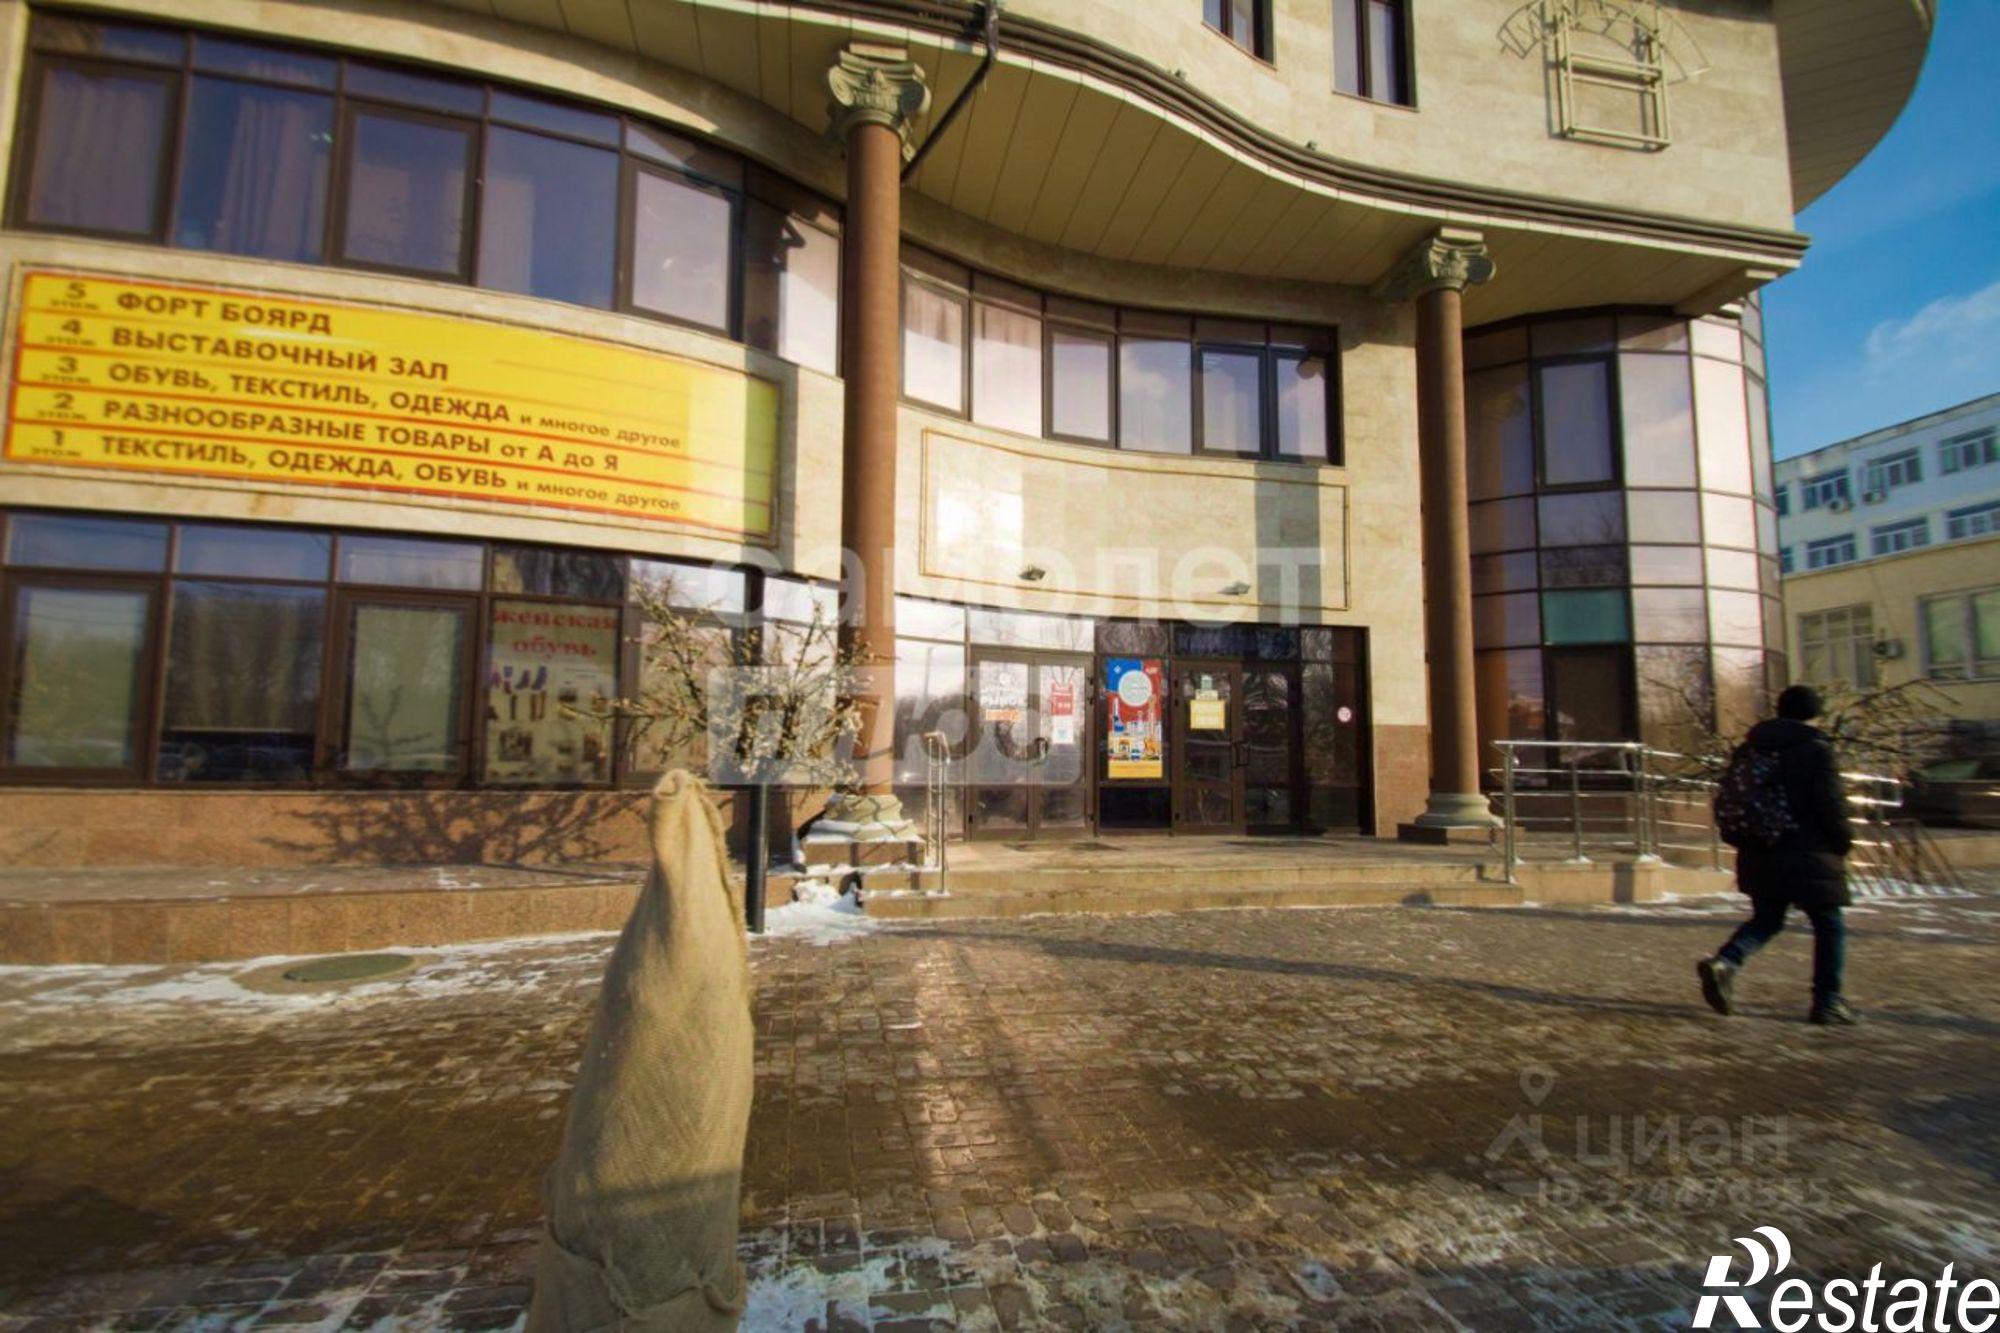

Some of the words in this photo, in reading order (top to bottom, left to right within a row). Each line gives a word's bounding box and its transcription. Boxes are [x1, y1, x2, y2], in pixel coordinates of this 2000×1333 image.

[66, 282, 87, 299] 5
[61, 319, 82, 335] 4
[117, 291, 210, 318] ФОРТ
[221, 298, 332, 335] БОЯРД
[58, 356, 78, 373] 3
[112, 327, 377, 373] ВЫСТАВОЧНЫЙ
[389, 357, 448, 381] ЗАЛ
[54, 392, 74, 409] 2
[109, 363, 216, 392] ОБУВЬ,
[231, 375, 378, 408] ТЕКСТИЛЬ,
[390, 390, 510, 422] ОДЕЖДА
[521, 414, 532, 424] и
[540, 417, 610, 437] многое
[616, 428, 681, 450] другое
[53, 429, 64, 446] 1
[104, 400, 364, 441] РАЗНООБРАЗНЫЕ
[377, 426, 490, 454] ТОВАРЫ
[501, 445, 526, 458] от
[538, 445, 554, 462] А
[564, 453, 594, 469] до
[604, 455, 619, 471] Я
[101, 434, 255, 467] ТЕКСТИЛЬ,
[269, 449, 402, 481] ОДЕЖДА,
[415, 463, 507, 488] ОБУВЬ
[517, 480, 528, 490] и
[537, 483, 608, 500] многое
[615, 490, 680, 511] другое
